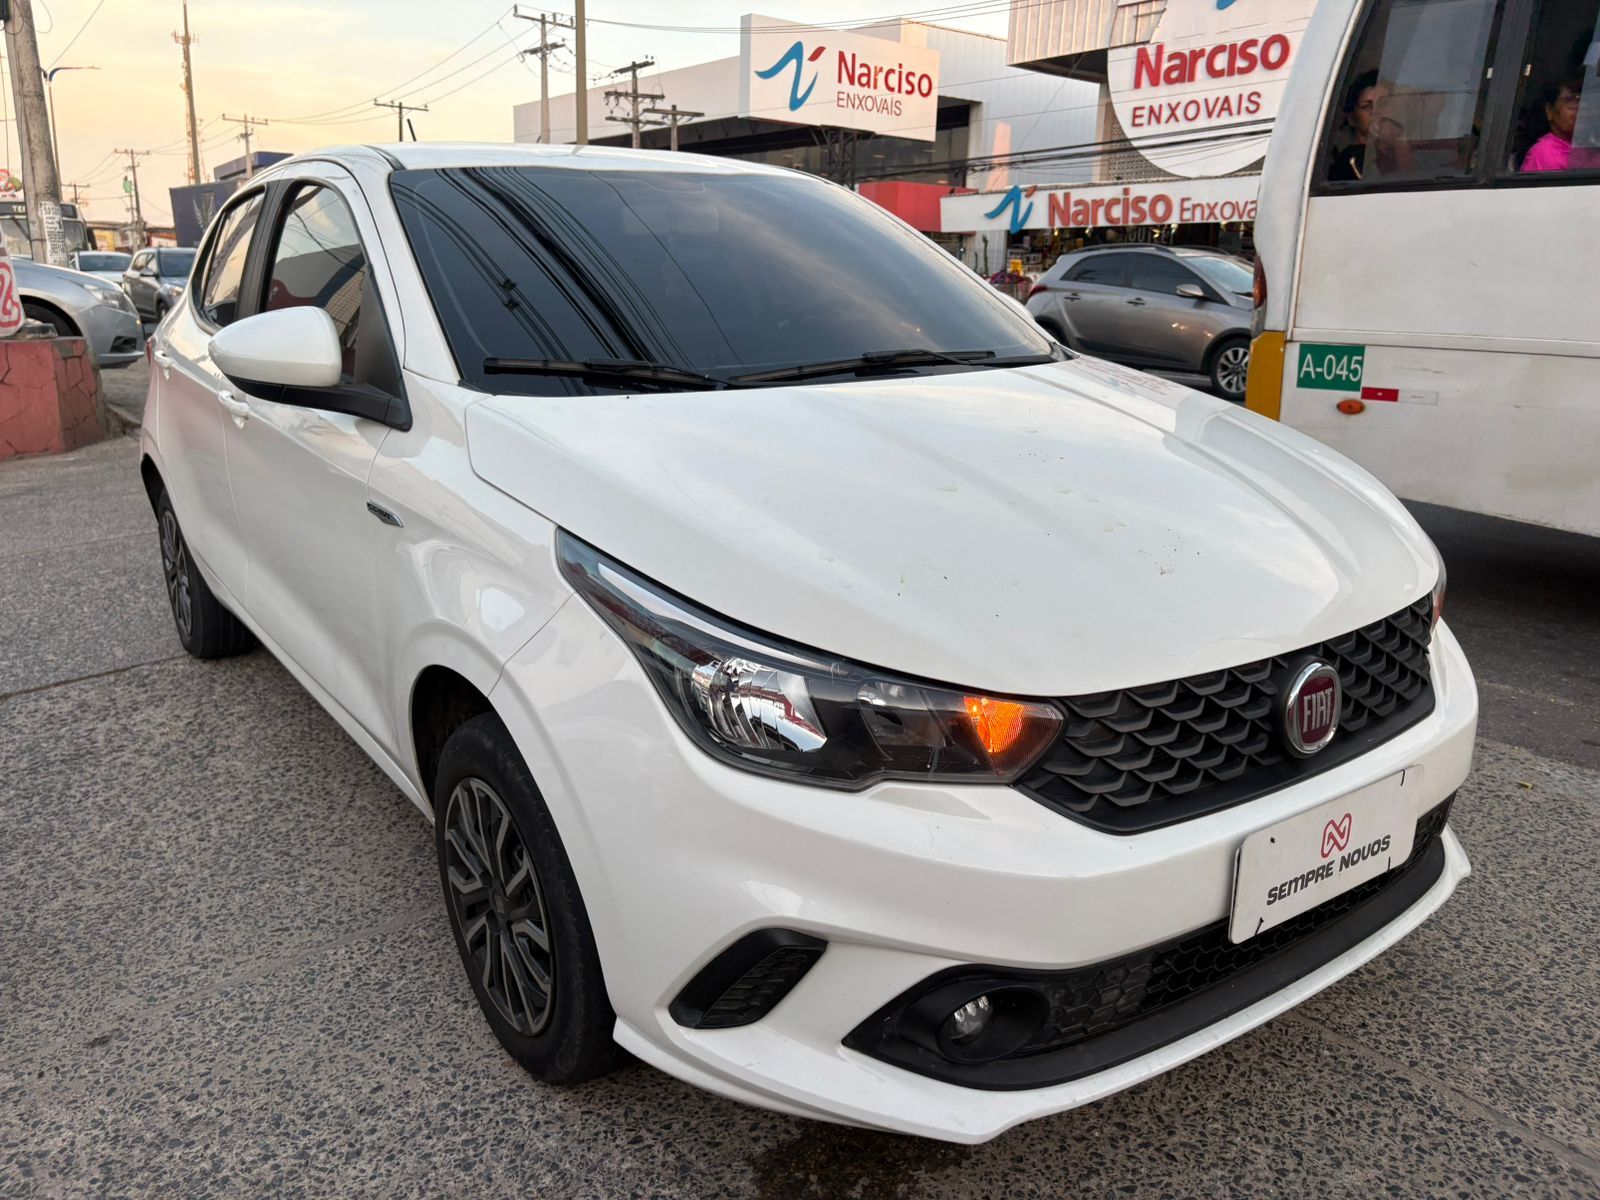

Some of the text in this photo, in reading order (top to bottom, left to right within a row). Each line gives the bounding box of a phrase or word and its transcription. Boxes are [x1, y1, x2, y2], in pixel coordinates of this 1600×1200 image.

[837, 50, 933, 98] Narciso
[1133, 33, 1290, 90] Narciso
[1131, 91, 1262, 128] ENXOVAIS
[1048, 187, 1173, 227] Narciso
[1299, 353, 1363, 382] A-045
[1303, 686, 1333, 734] FIAT
[1266, 834, 1391, 906] SEMPRE NOVOS
